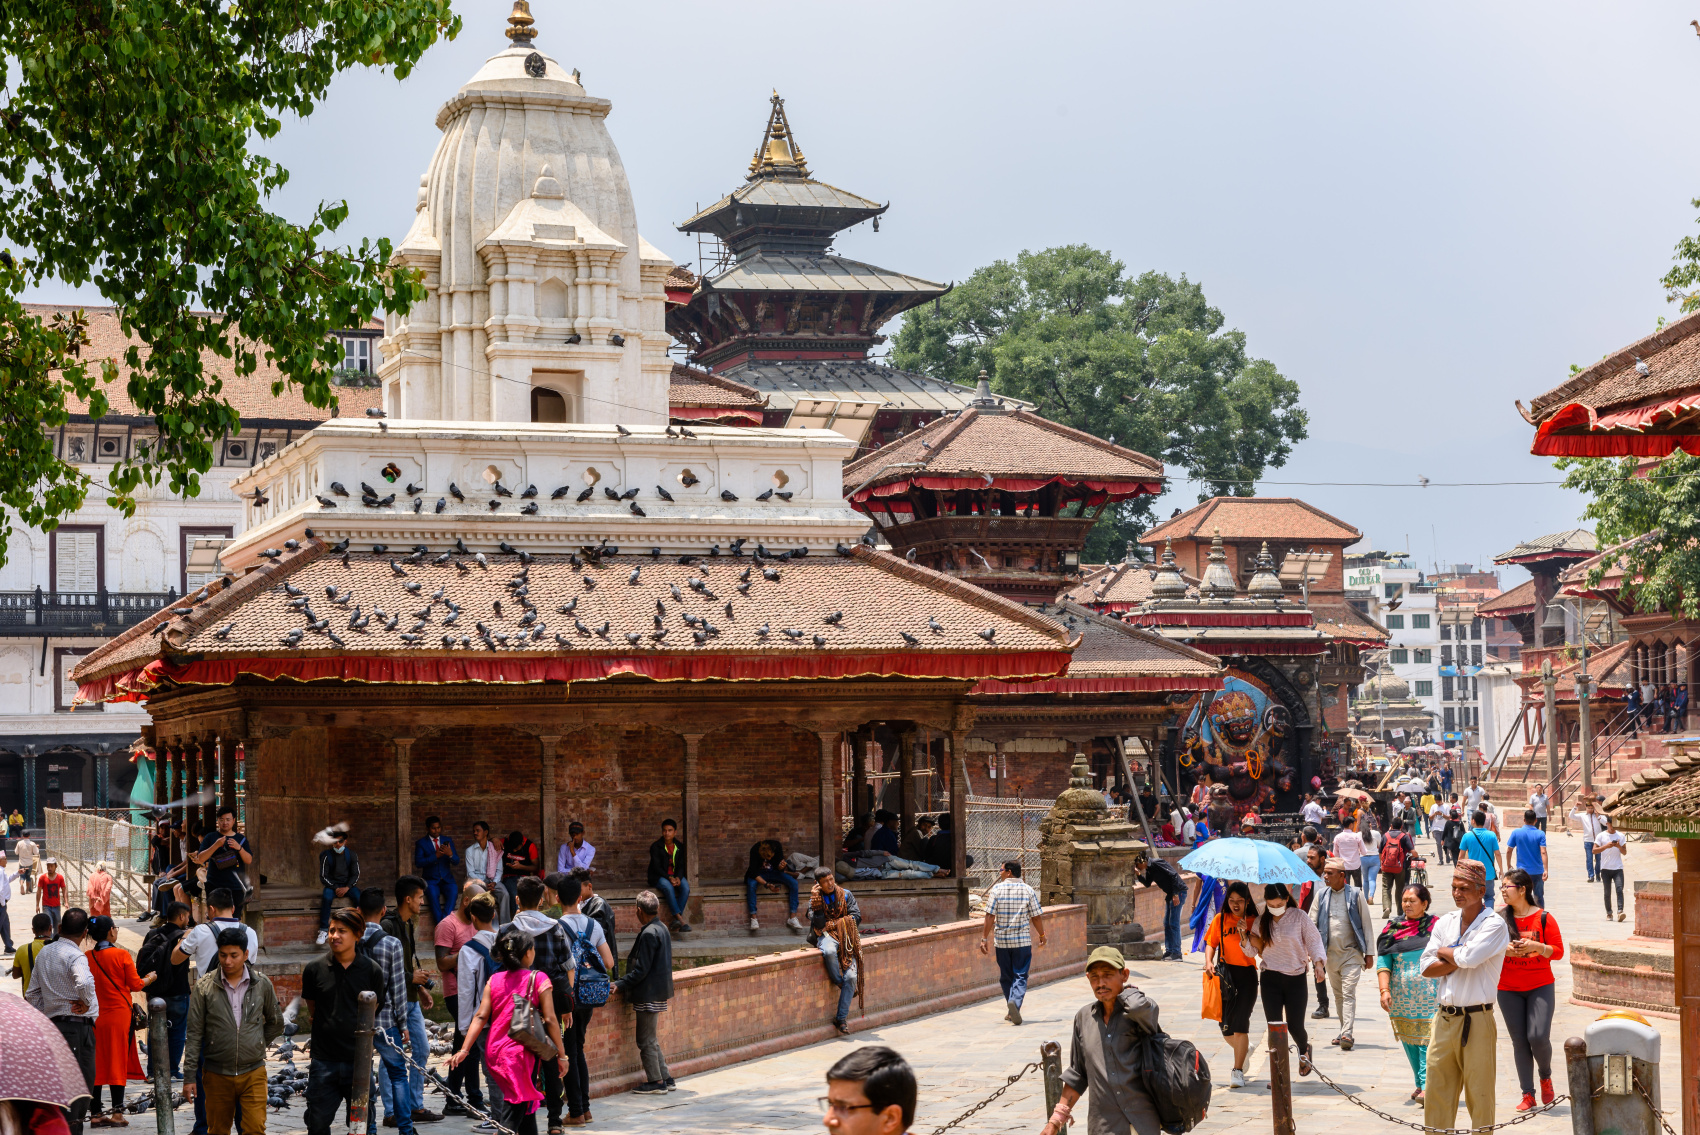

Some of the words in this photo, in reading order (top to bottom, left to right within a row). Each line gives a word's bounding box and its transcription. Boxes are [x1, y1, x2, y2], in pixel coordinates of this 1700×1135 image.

[1358, 568, 1371, 576] OLD
[1349, 573, 1381, 586] DURBAR
[1628, 817, 1662, 832] Hanuman
[1664, 819, 1687, 833] Dhoka
[1688, 820, 1700, 833] Du
